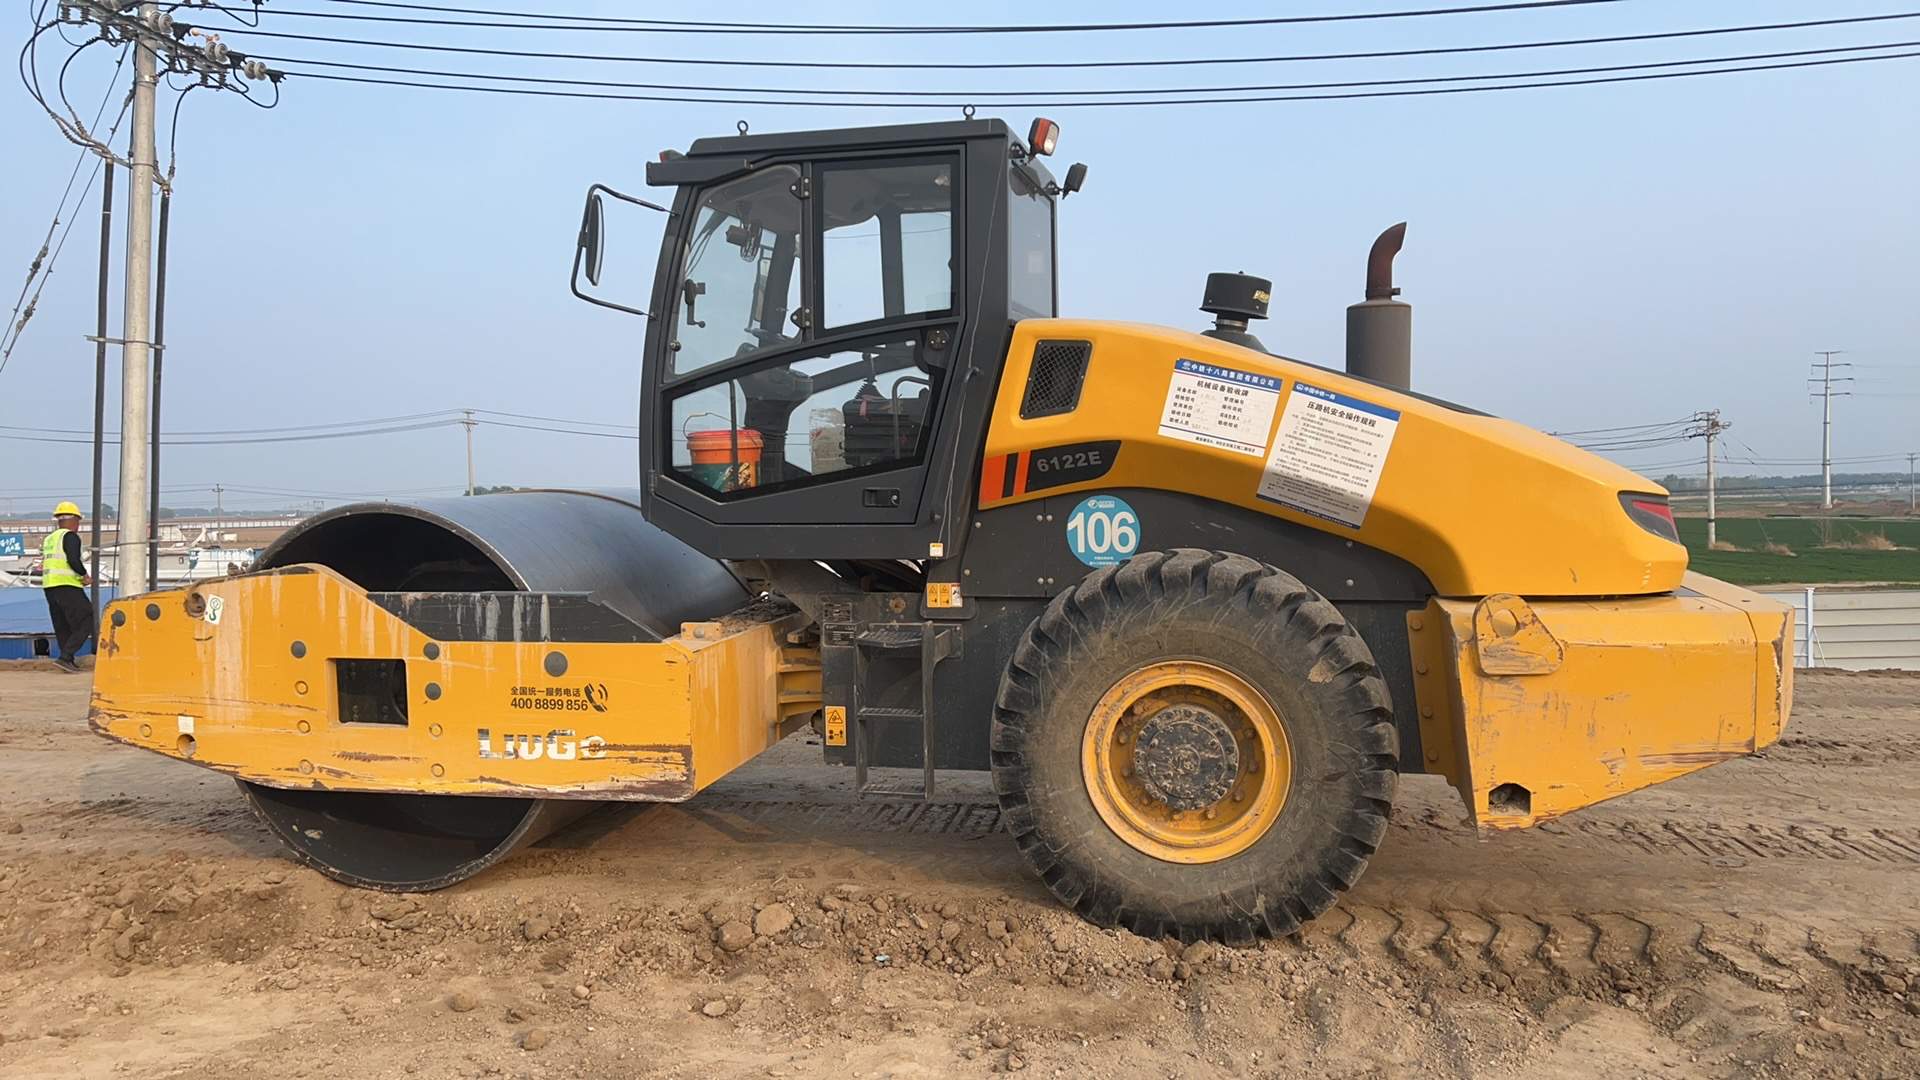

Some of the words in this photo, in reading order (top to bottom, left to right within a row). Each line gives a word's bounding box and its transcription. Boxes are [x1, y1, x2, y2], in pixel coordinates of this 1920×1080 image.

[1191, 363, 1274, 387] 中铁十八局集团有限公司
[1197, 380, 1249, 397] 机械设备验收牌
[1306, 401, 1377, 428] 压路机安全操作规程
[1036, 450, 1102, 473] 6122E
[1067, 511, 1137, 554] 106
[511, 686, 581, 698] 全国统一服务电话
[511, 697, 533, 710] 400
[534, 698, 564, 711] 8899
[566, 699, 589, 712] 856
